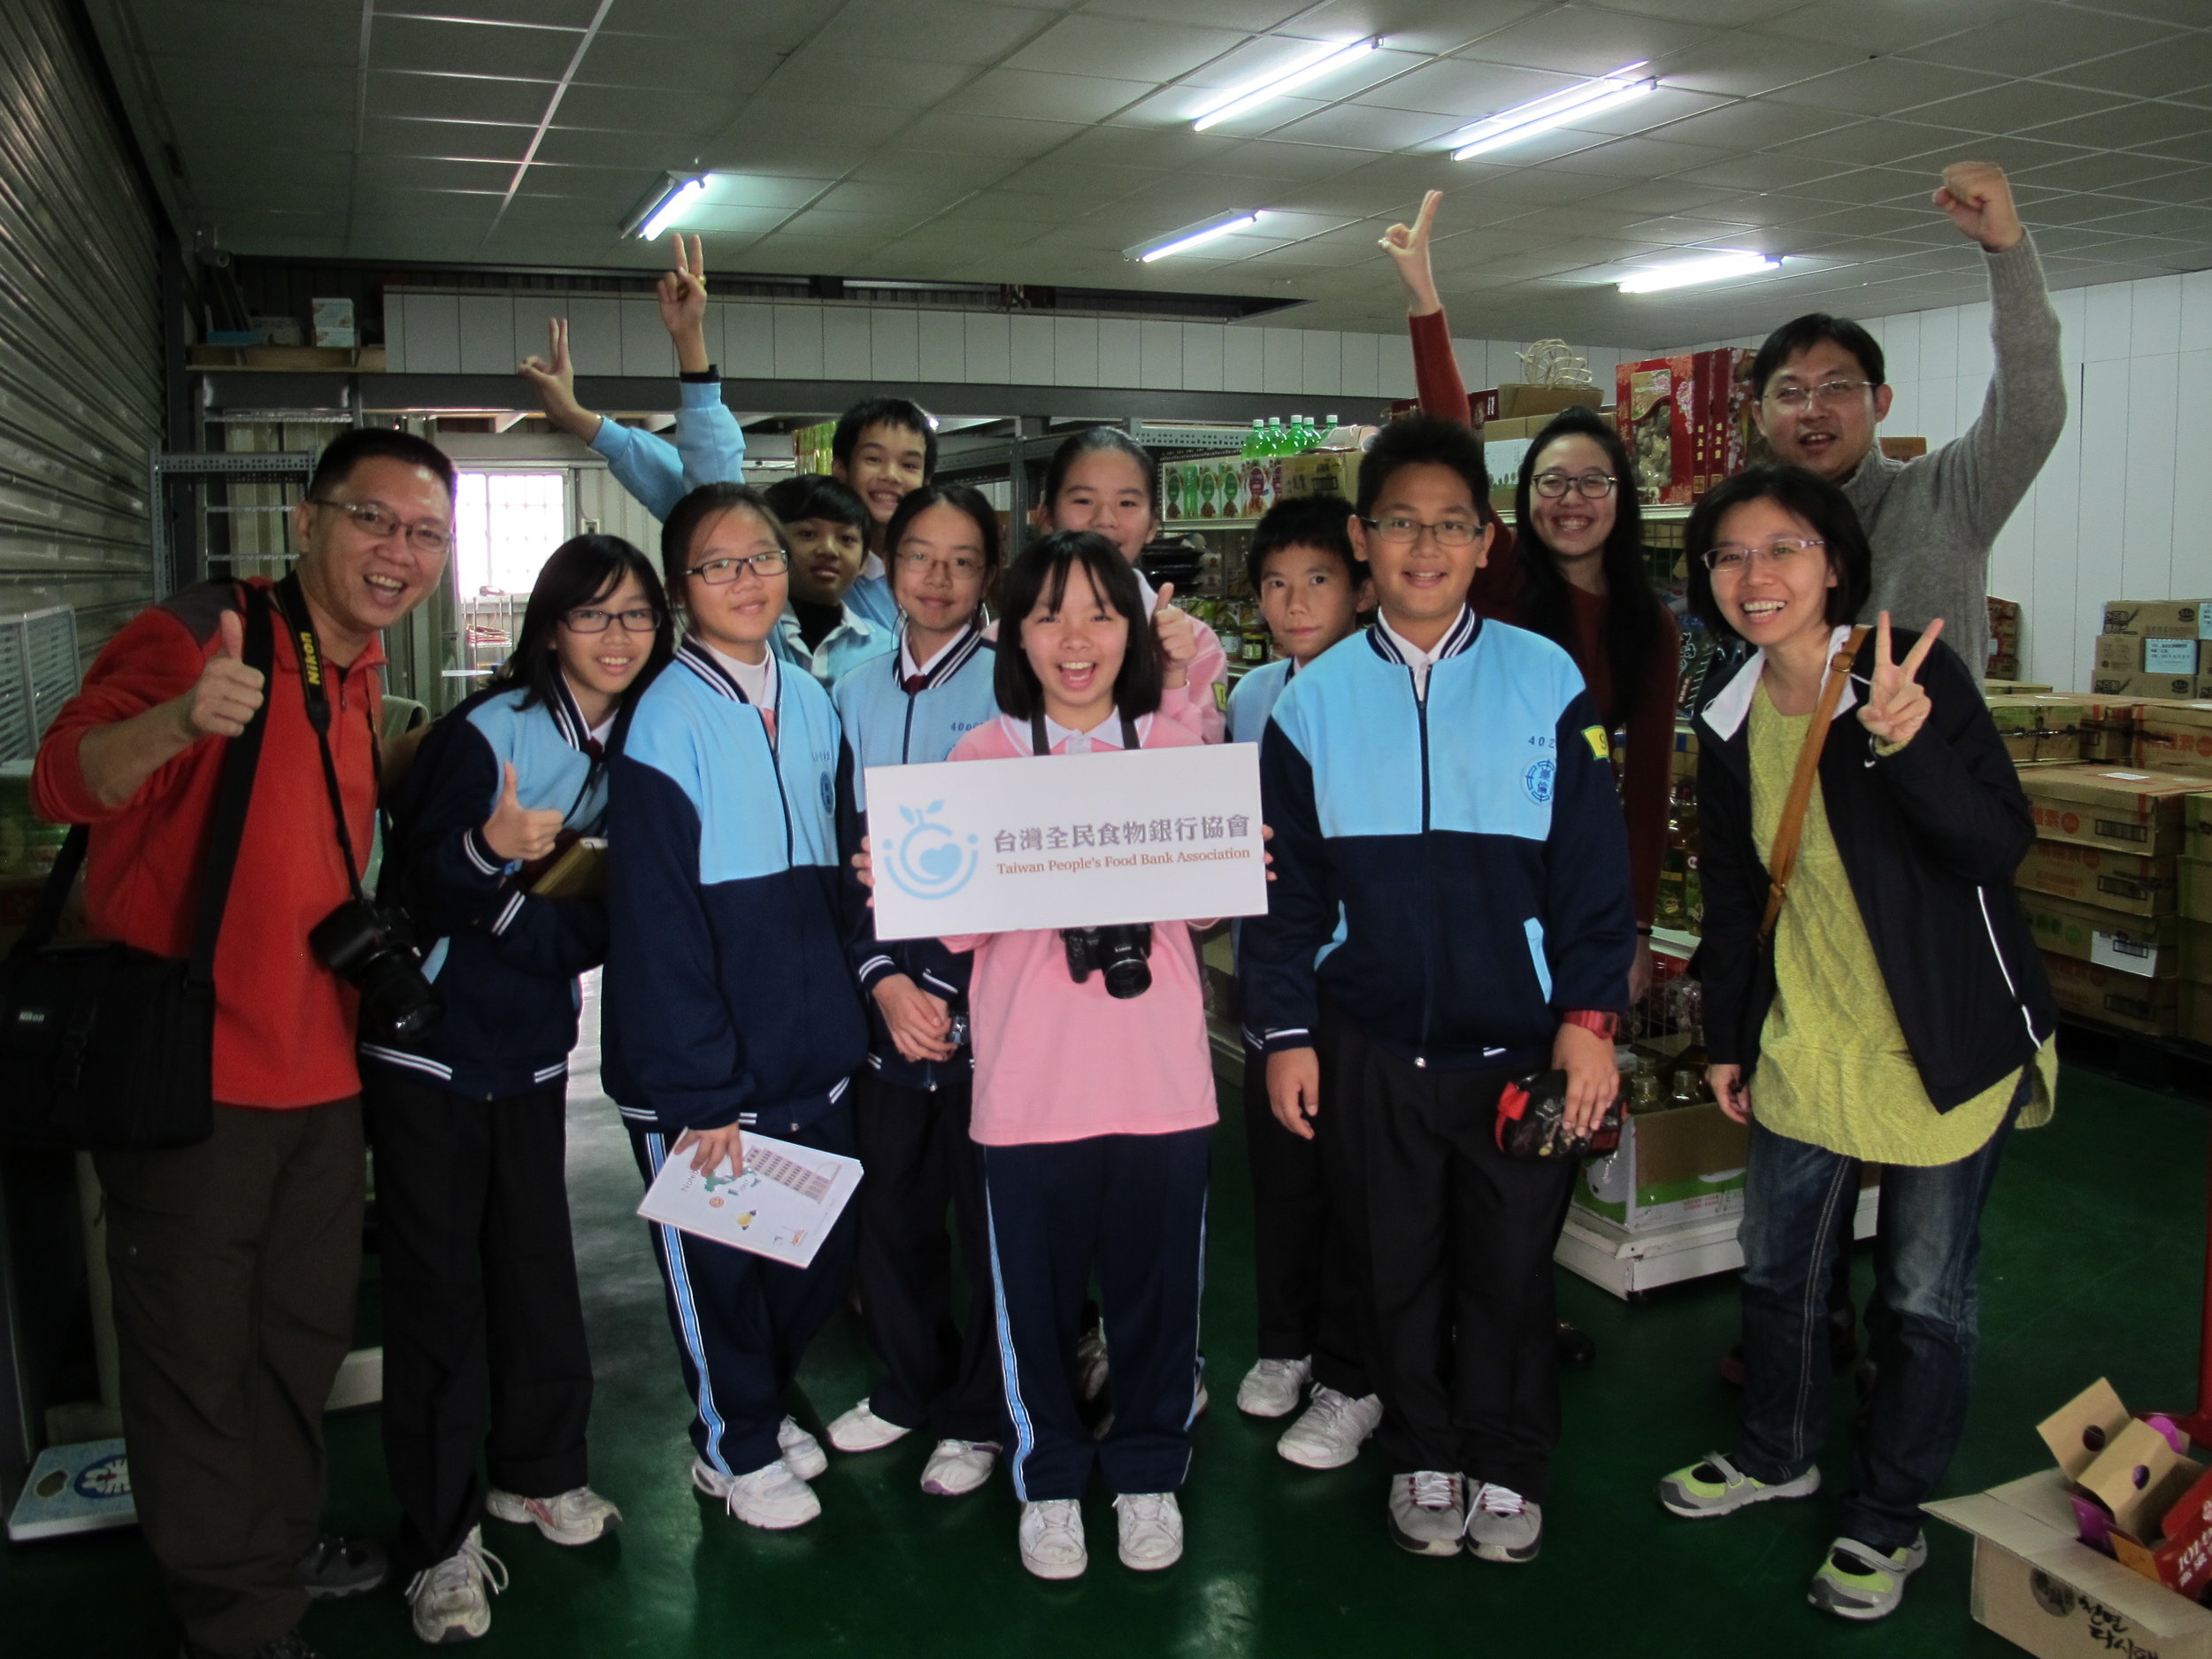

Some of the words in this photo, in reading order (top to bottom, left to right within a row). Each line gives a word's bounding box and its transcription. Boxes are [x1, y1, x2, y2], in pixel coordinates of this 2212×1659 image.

[300, 632, 320, 685] Nikon
[994, 814, 1250, 853] 台灣全民食物銀行協會
[996, 862, 1045, 875] Taiwan
[1048, 856, 1101, 873] People's
[1105, 854, 1137, 868] Food
[1141, 851, 1173, 865] Bank
[1178, 848, 1250, 864] Association
[19, 1010, 45, 1022] Nikon
